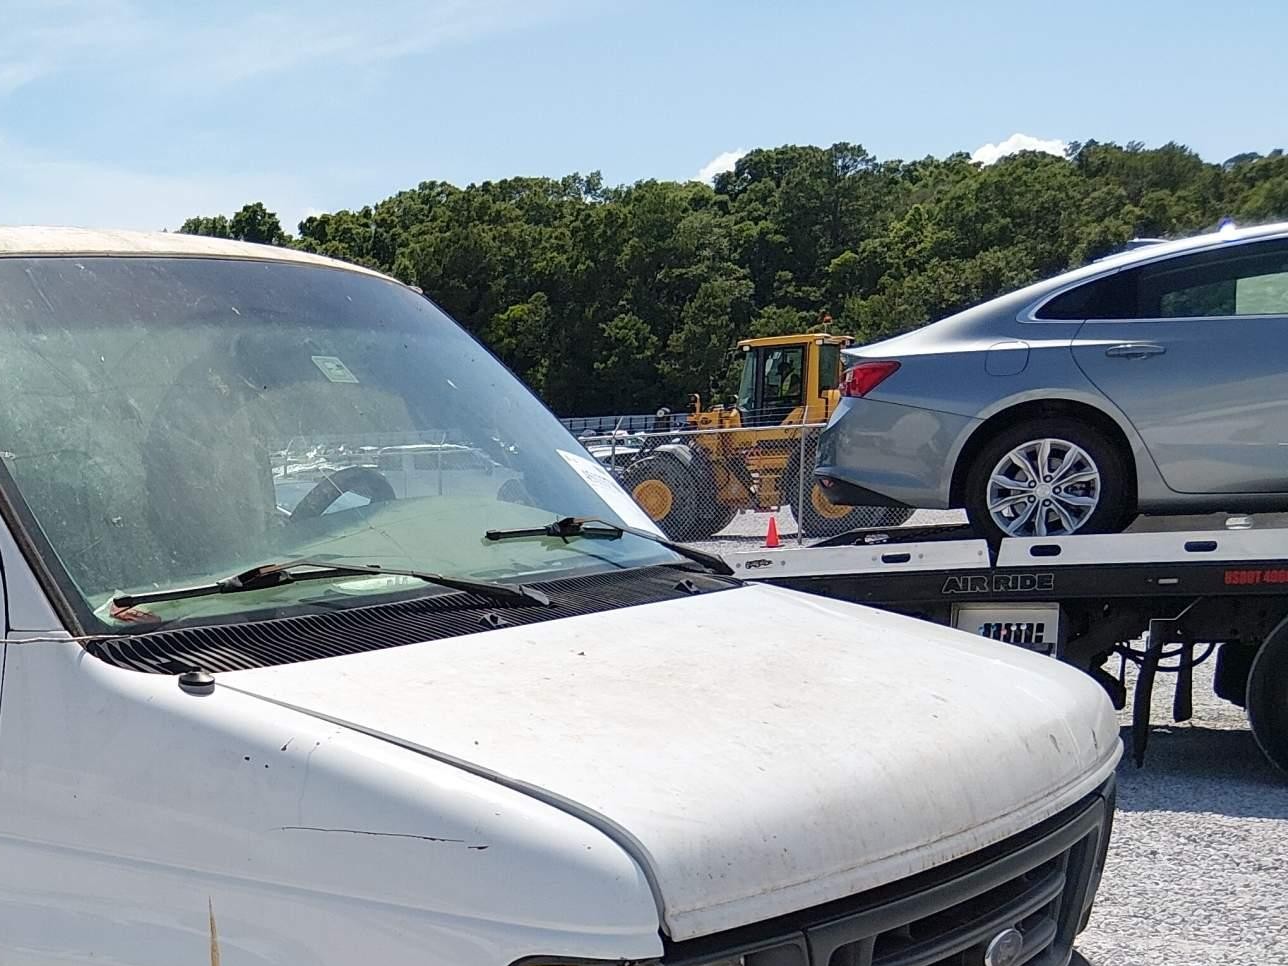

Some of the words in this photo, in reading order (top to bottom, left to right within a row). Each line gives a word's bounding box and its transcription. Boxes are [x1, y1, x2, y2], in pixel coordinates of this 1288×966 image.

[942, 576, 989, 593] AIR
[992, 573, 1054, 592] RIDE
[1224, 570, 1262, 585] USDOT
